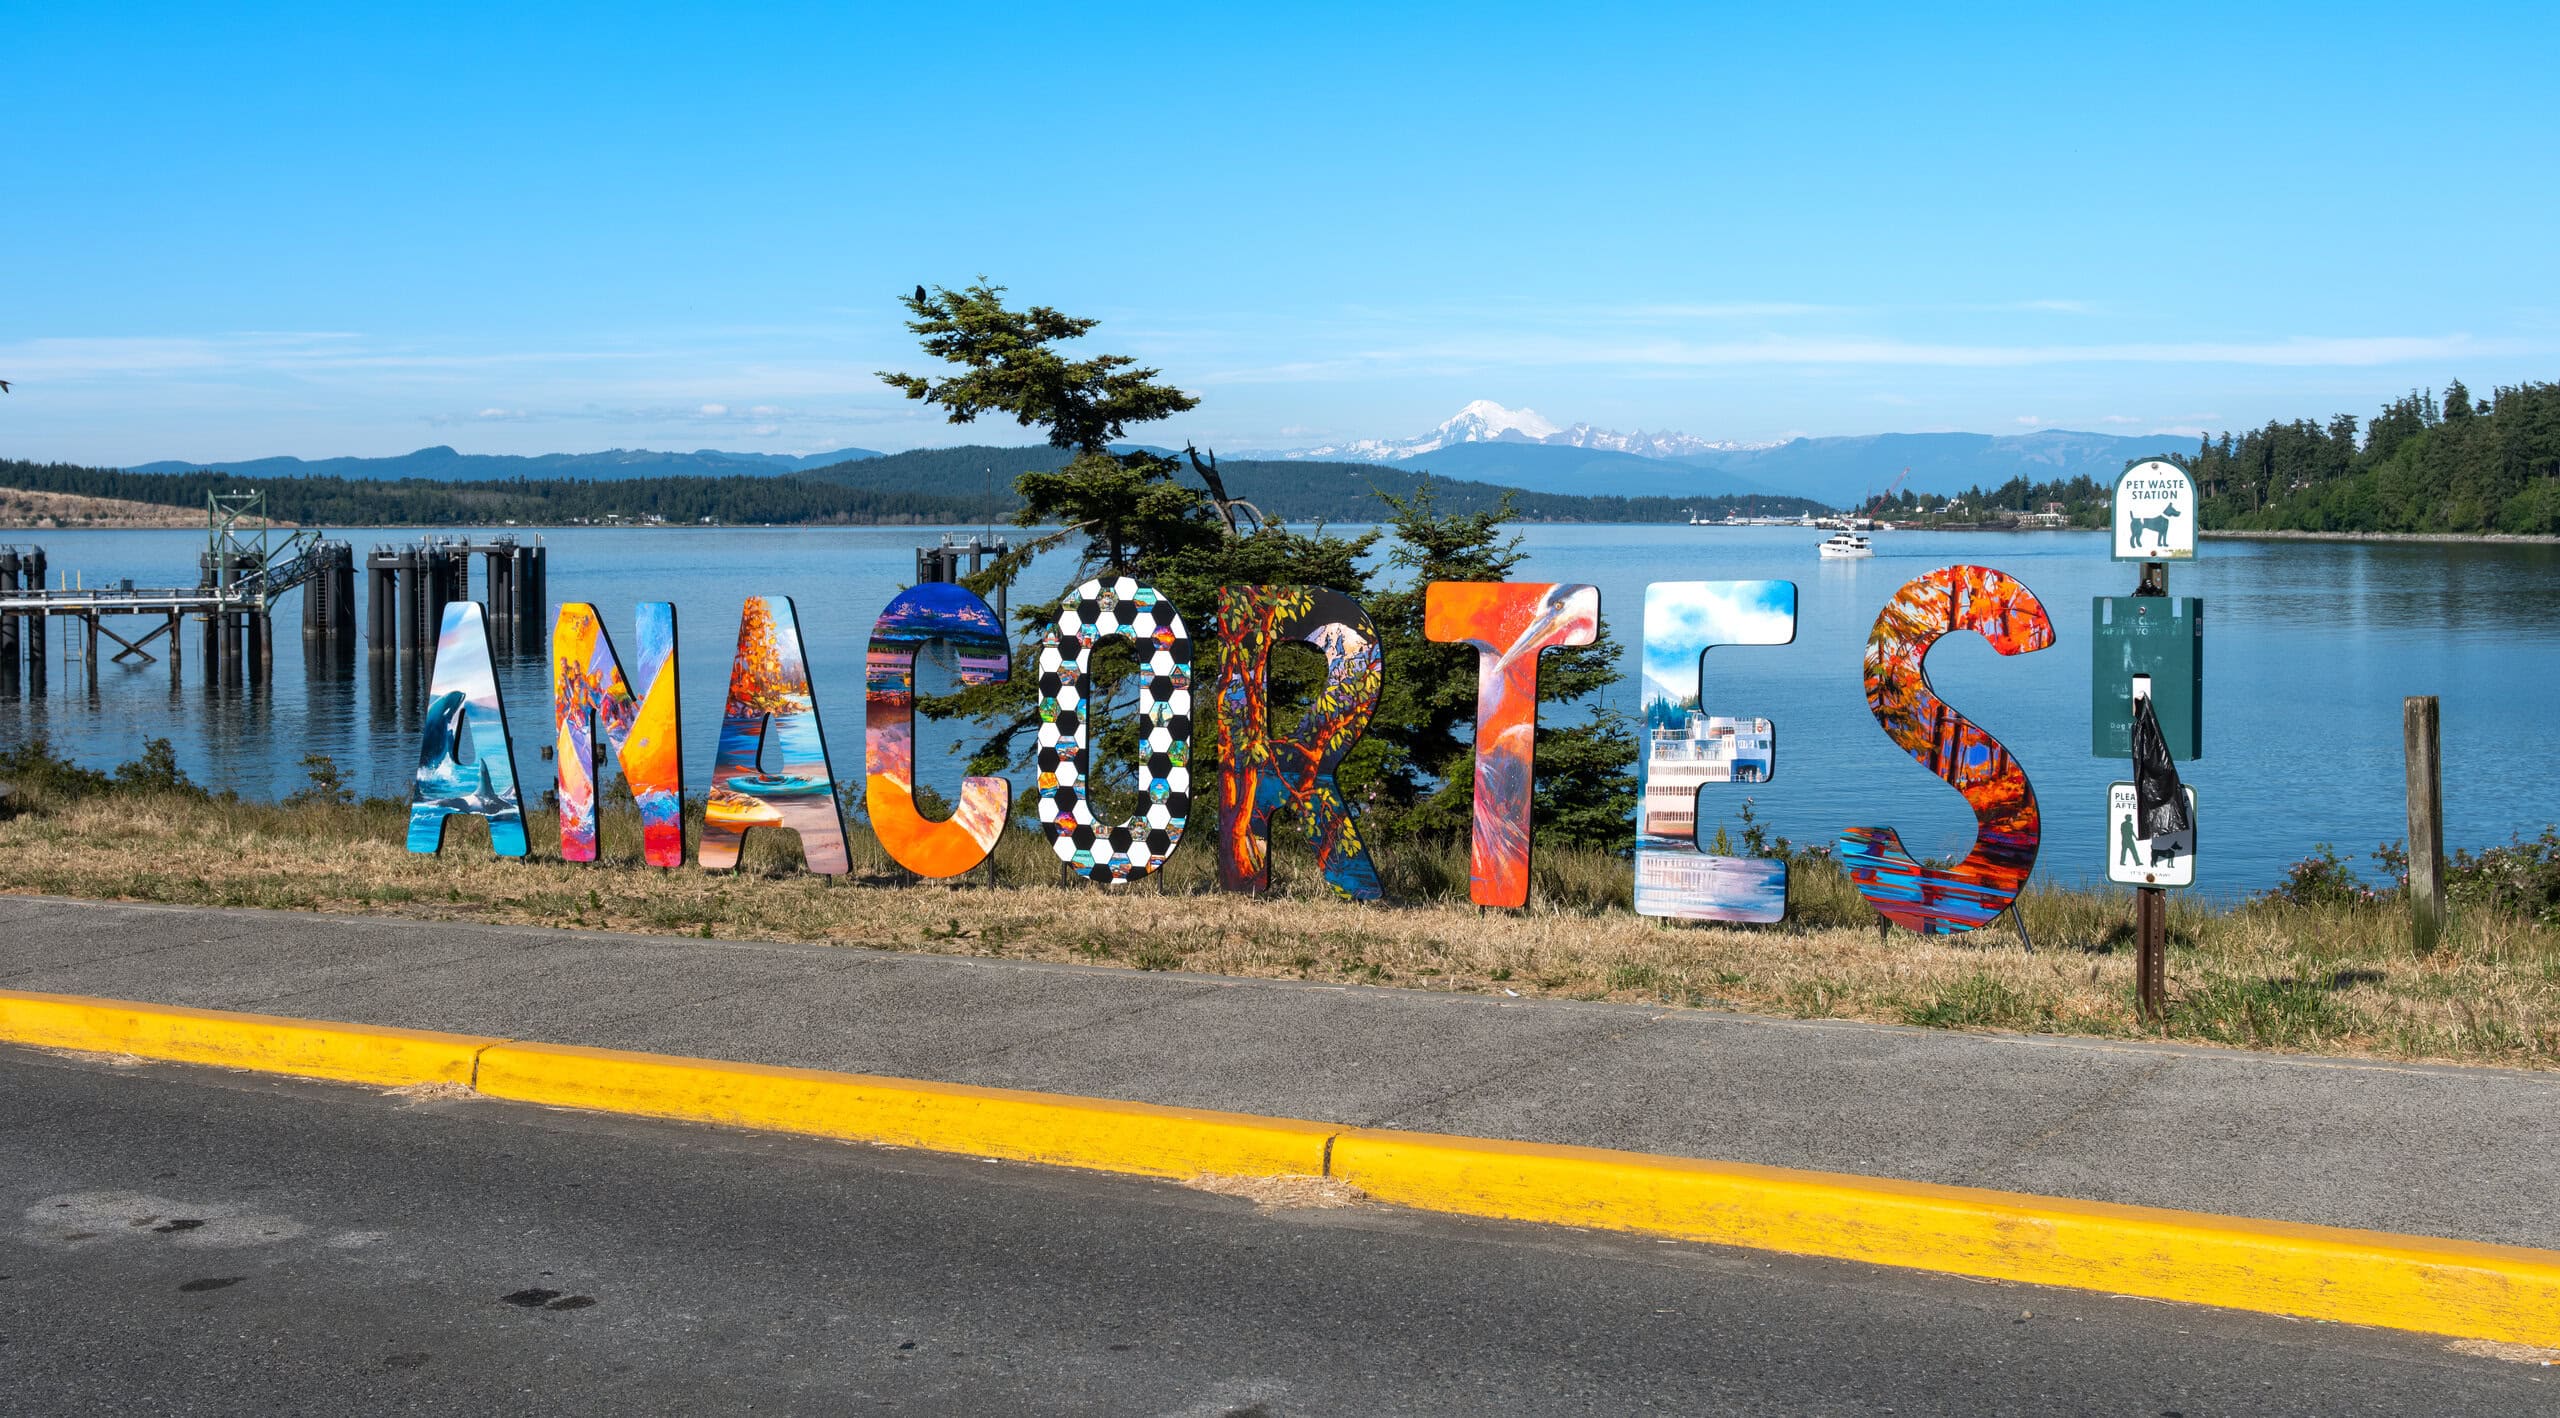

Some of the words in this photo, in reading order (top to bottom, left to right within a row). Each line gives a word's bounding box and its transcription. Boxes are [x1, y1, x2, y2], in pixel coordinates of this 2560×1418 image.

[2126, 480, 2144, 489] PET
[2148, 480, 2184, 489] WASTE
[2132, 490, 2178, 500] STATION
[406, 565, 2056, 935] ANACORTES
[2115, 792, 2136, 801] PLEA
[2115, 802, 2137, 810] AFTE
